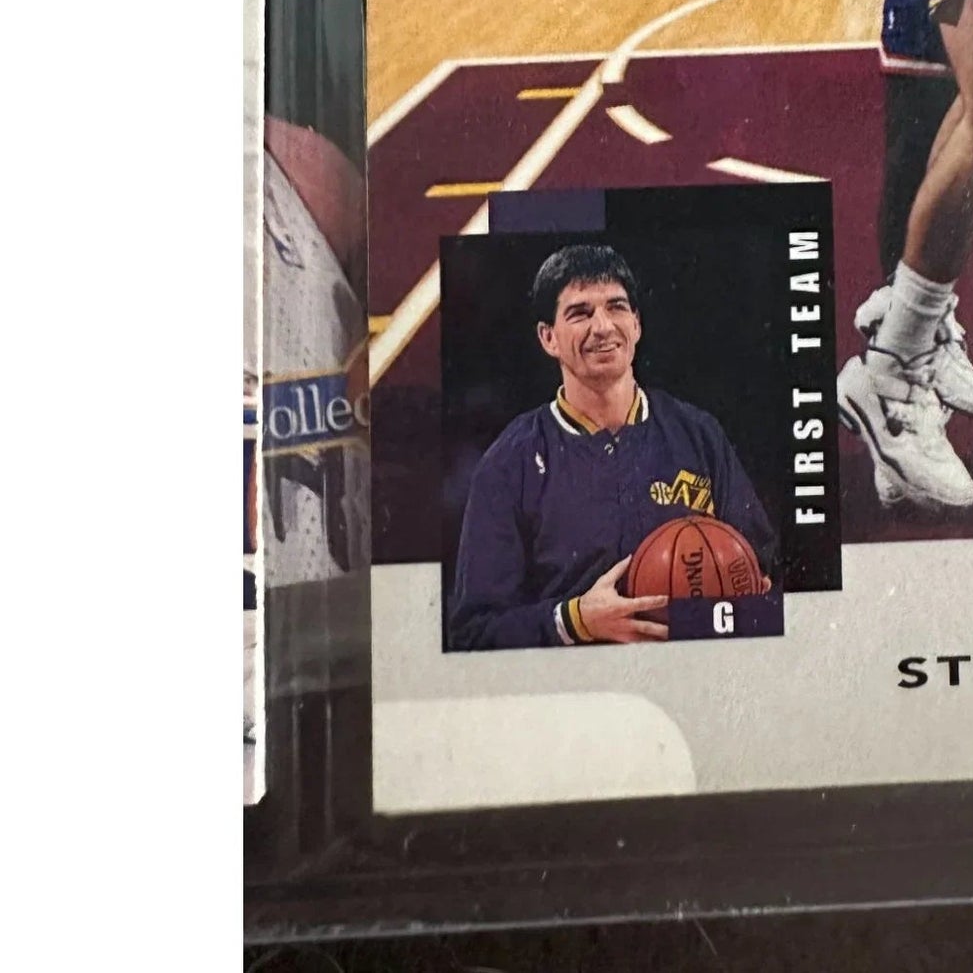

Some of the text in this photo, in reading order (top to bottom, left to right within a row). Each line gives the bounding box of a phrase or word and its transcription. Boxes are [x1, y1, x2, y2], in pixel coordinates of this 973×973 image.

[788, 231, 826, 525] FIRST TEAM
[264, 383, 370, 439] ollec
[713, 601, 735, 635] G
